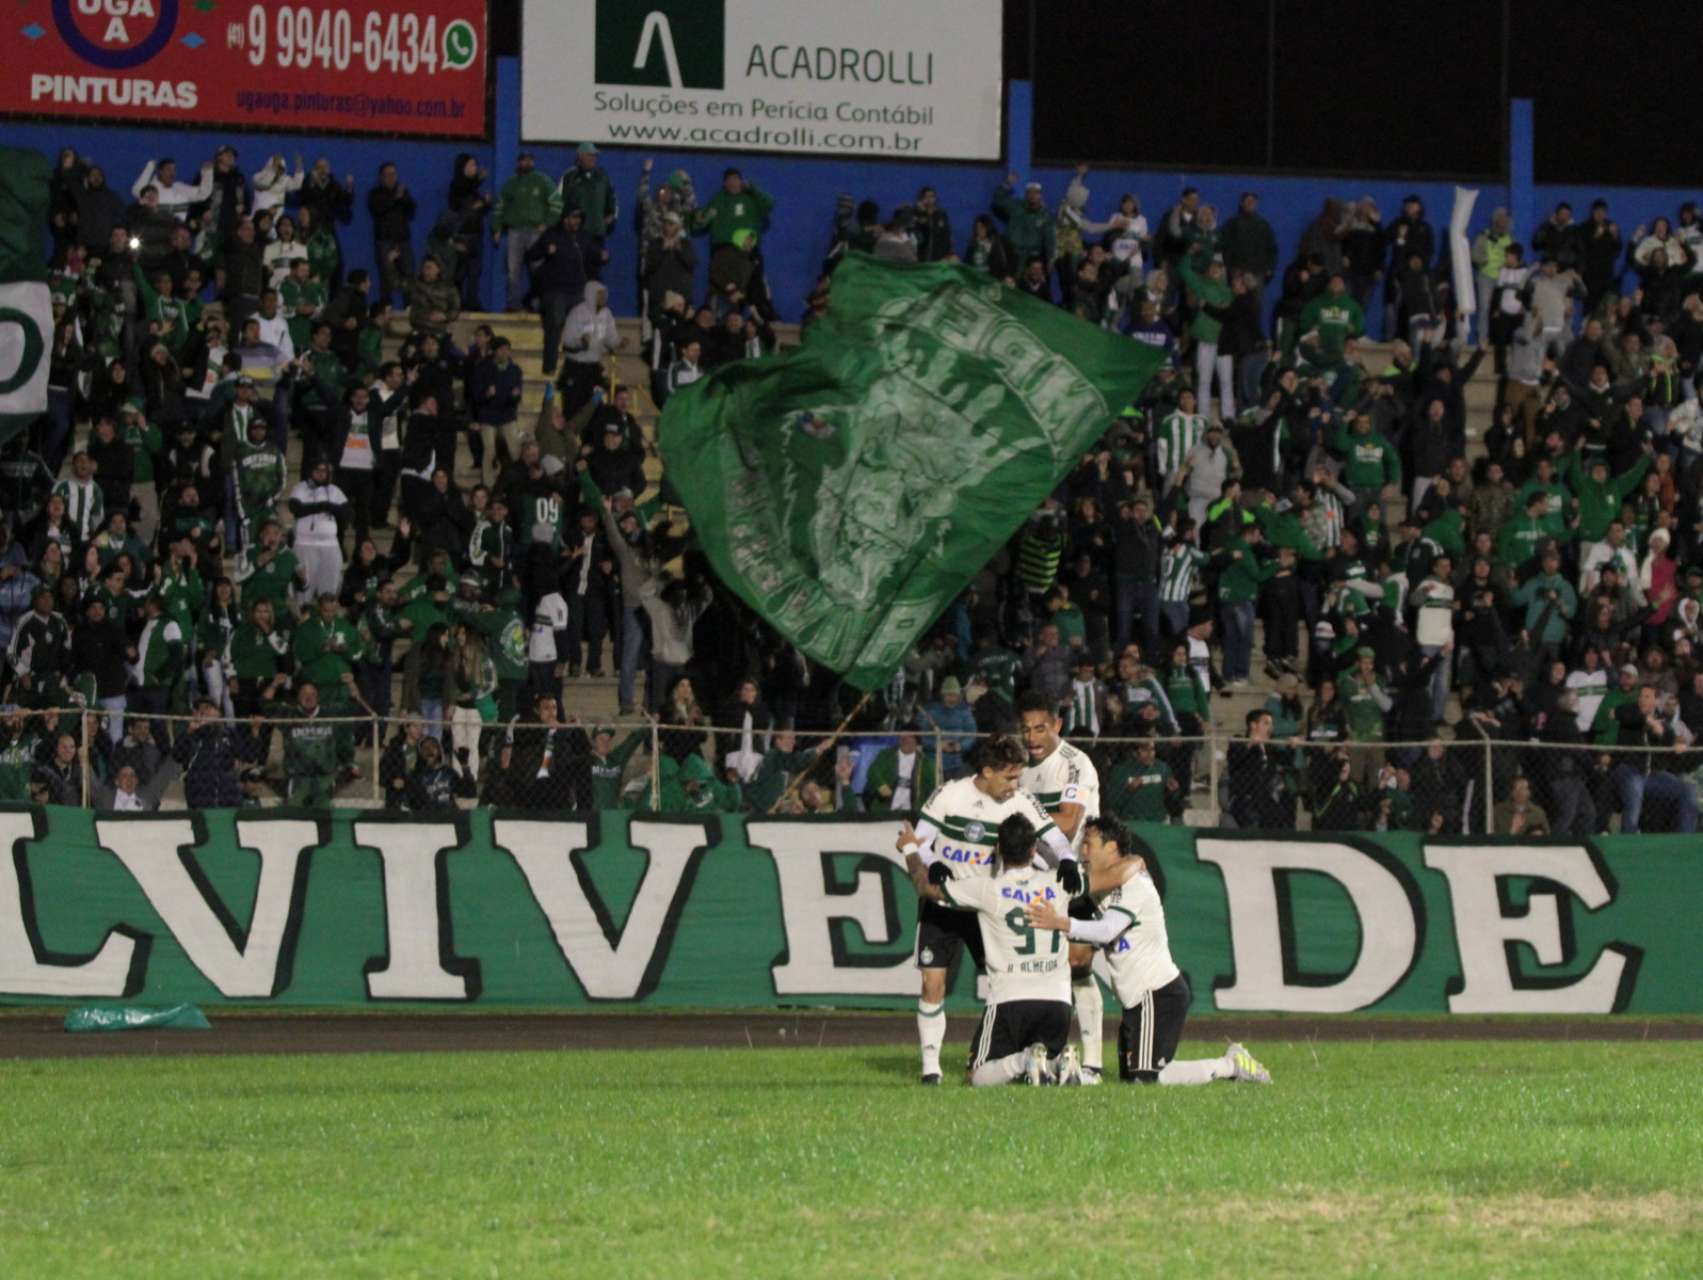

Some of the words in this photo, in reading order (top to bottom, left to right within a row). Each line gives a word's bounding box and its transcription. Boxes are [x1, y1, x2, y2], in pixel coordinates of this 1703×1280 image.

[103, 17, 129, 43] A
[249, 4, 267, 66] 9
[276, 6, 438, 75] 9940-6434
[745, 44, 933, 84] ACADROLLI
[31, 73, 198, 109] PINTURAS
[593, 91, 698, 117] Soluções
[706, 101, 743, 117] em
[751, 98, 828, 121] Perícia
[835, 101, 934, 126] Contábil
[607, 123, 924, 150] www.acadrolli.com.br
[942, 846, 996, 865] CAIXA
[1001, 886, 1055, 904] CAIXA
